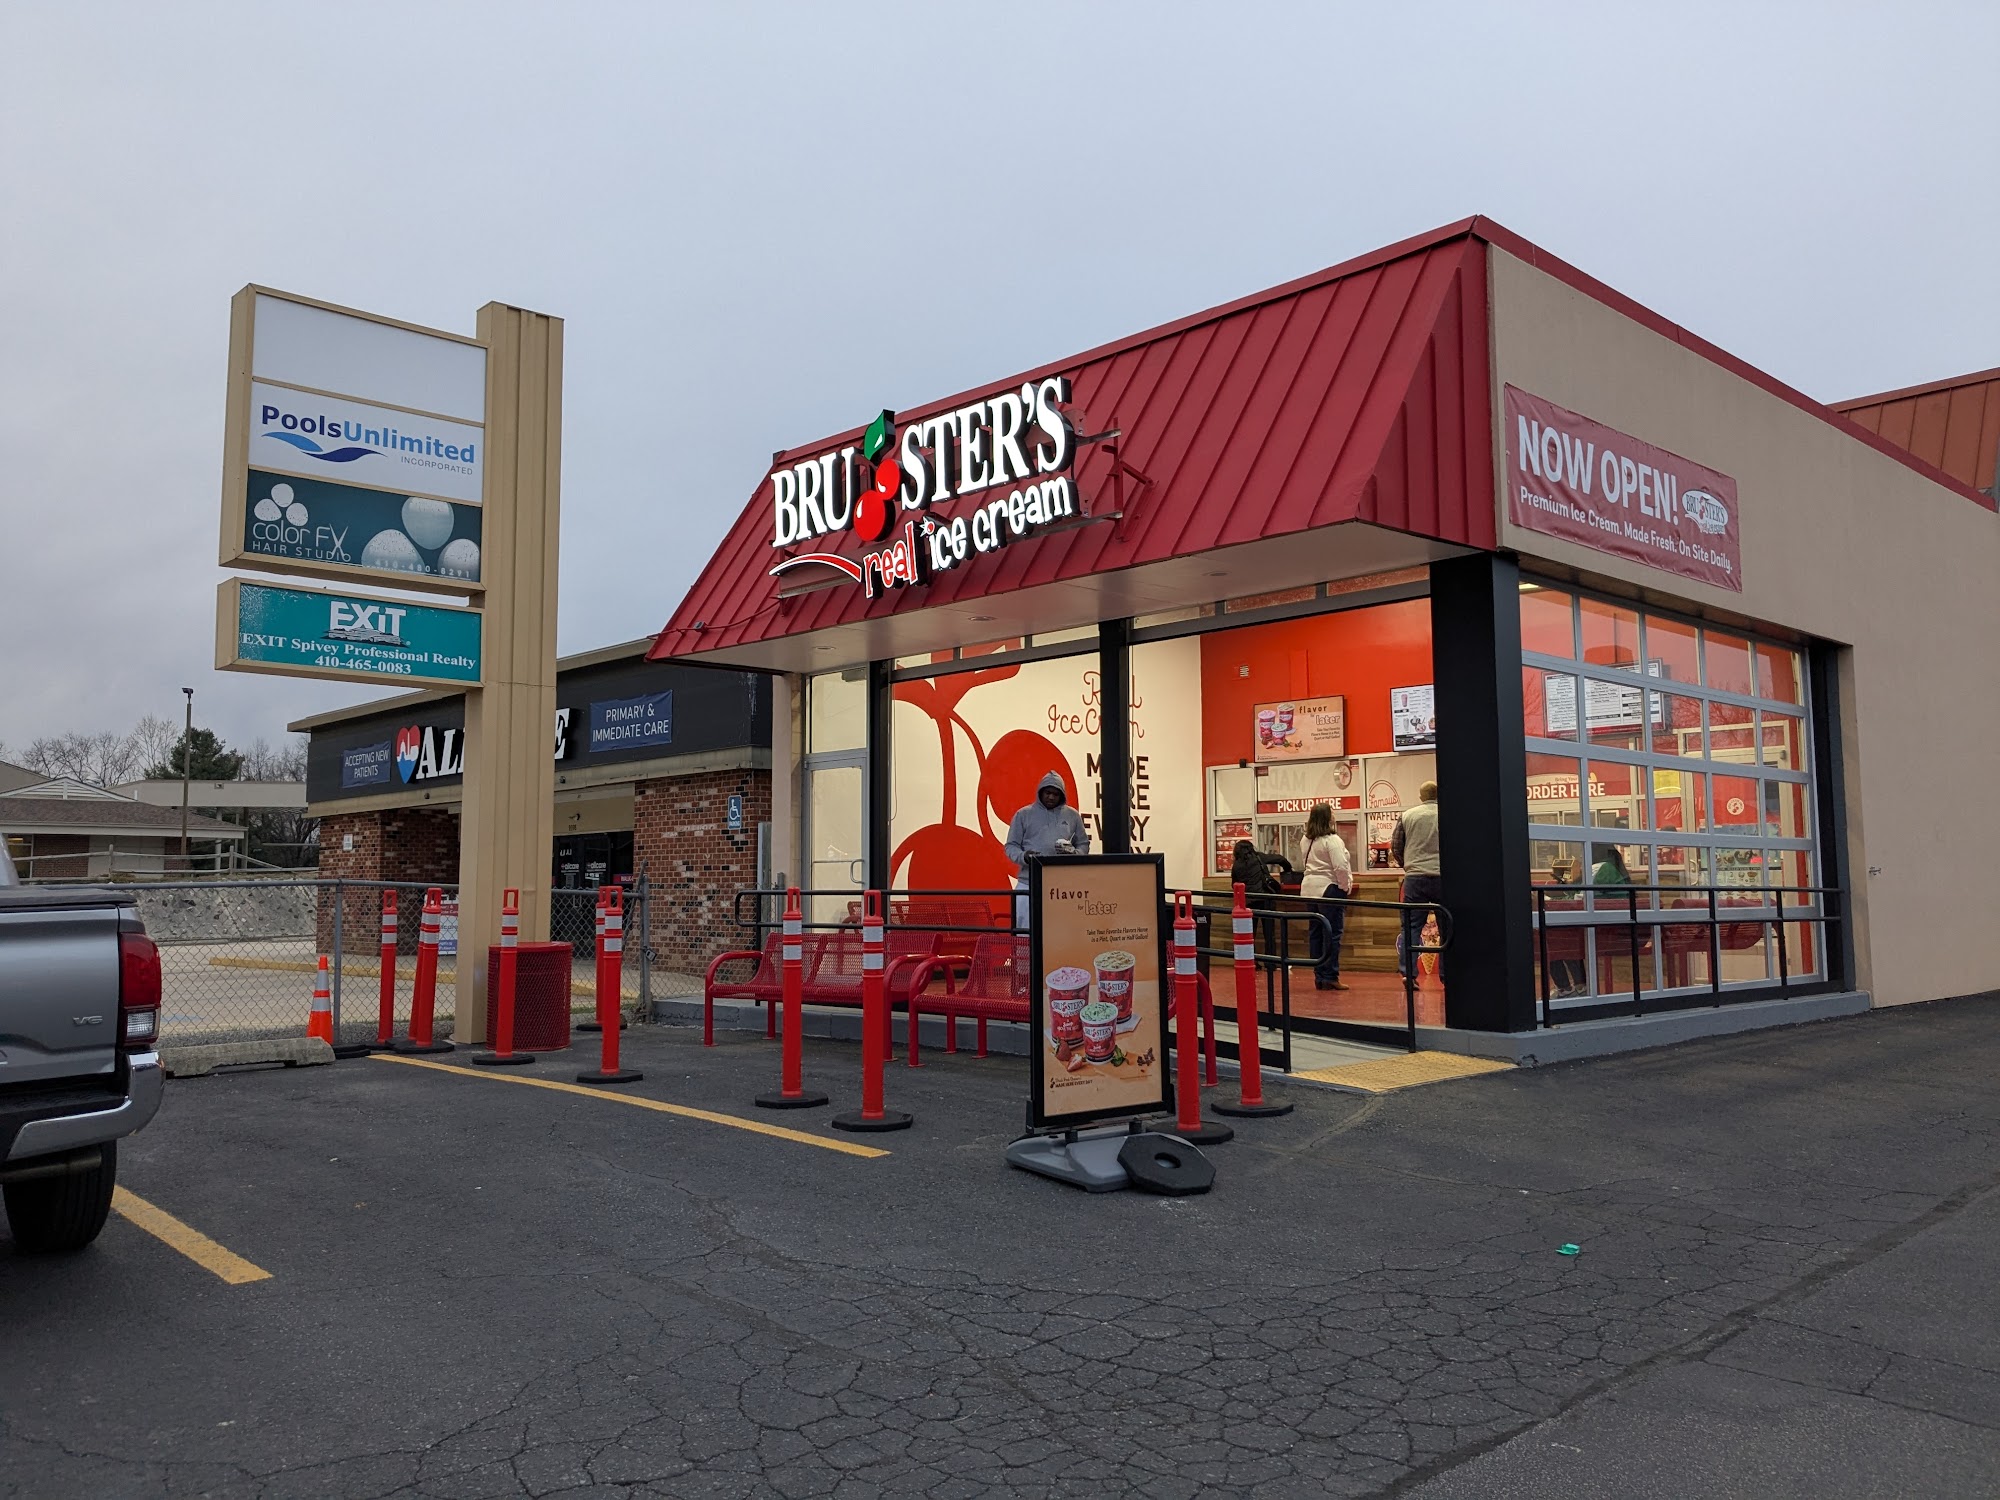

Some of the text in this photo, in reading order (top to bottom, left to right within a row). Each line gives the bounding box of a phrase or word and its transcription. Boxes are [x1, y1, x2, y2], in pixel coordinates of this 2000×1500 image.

[262, 405, 475, 463] PoolsUnlimited
[401, 456, 473, 475] INCORPORATED
[771, 377, 1063, 548] BRUSTER'S
[1518, 414, 1679, 526] NOW OPEN!
[863, 475, 1073, 599] real ice cream
[1520, 486, 1733, 574] Premium Ice Cream. Made Fresh. On Site Daily.
[252, 542, 351, 562] HAIR STUDIO
[375, 560, 471, 578] 410-480-8291
[242, 633, 476, 669] EXIT Spivey Professional Realty
[315, 655, 412, 674] 410-465-0083
[606, 703, 655, 722] PRIMARY &
[1048, 704, 1083, 734] Ice
[1316, 715, 1340, 725] later
[592, 719, 669, 742] IMMEDIATE CARE
[344, 750, 389, 768] ACCEPTING NEW
[353, 765, 379, 778] PATIENTS
[1527, 783, 1605, 800] ORDER HRE
[1277, 799, 1299, 812] PICK
[1301, 798, 1314, 811] UP
[1369, 794, 1398, 808] Famous
[1369, 812, 1399, 821] WAFFLE
[1376, 822, 1393, 830] CONES
[1050, 888, 1089, 900] flavor
[1085, 900, 1117, 915] later
[1109, 935, 1121, 943] Quart
[72, 1015, 103, 1025] V6
